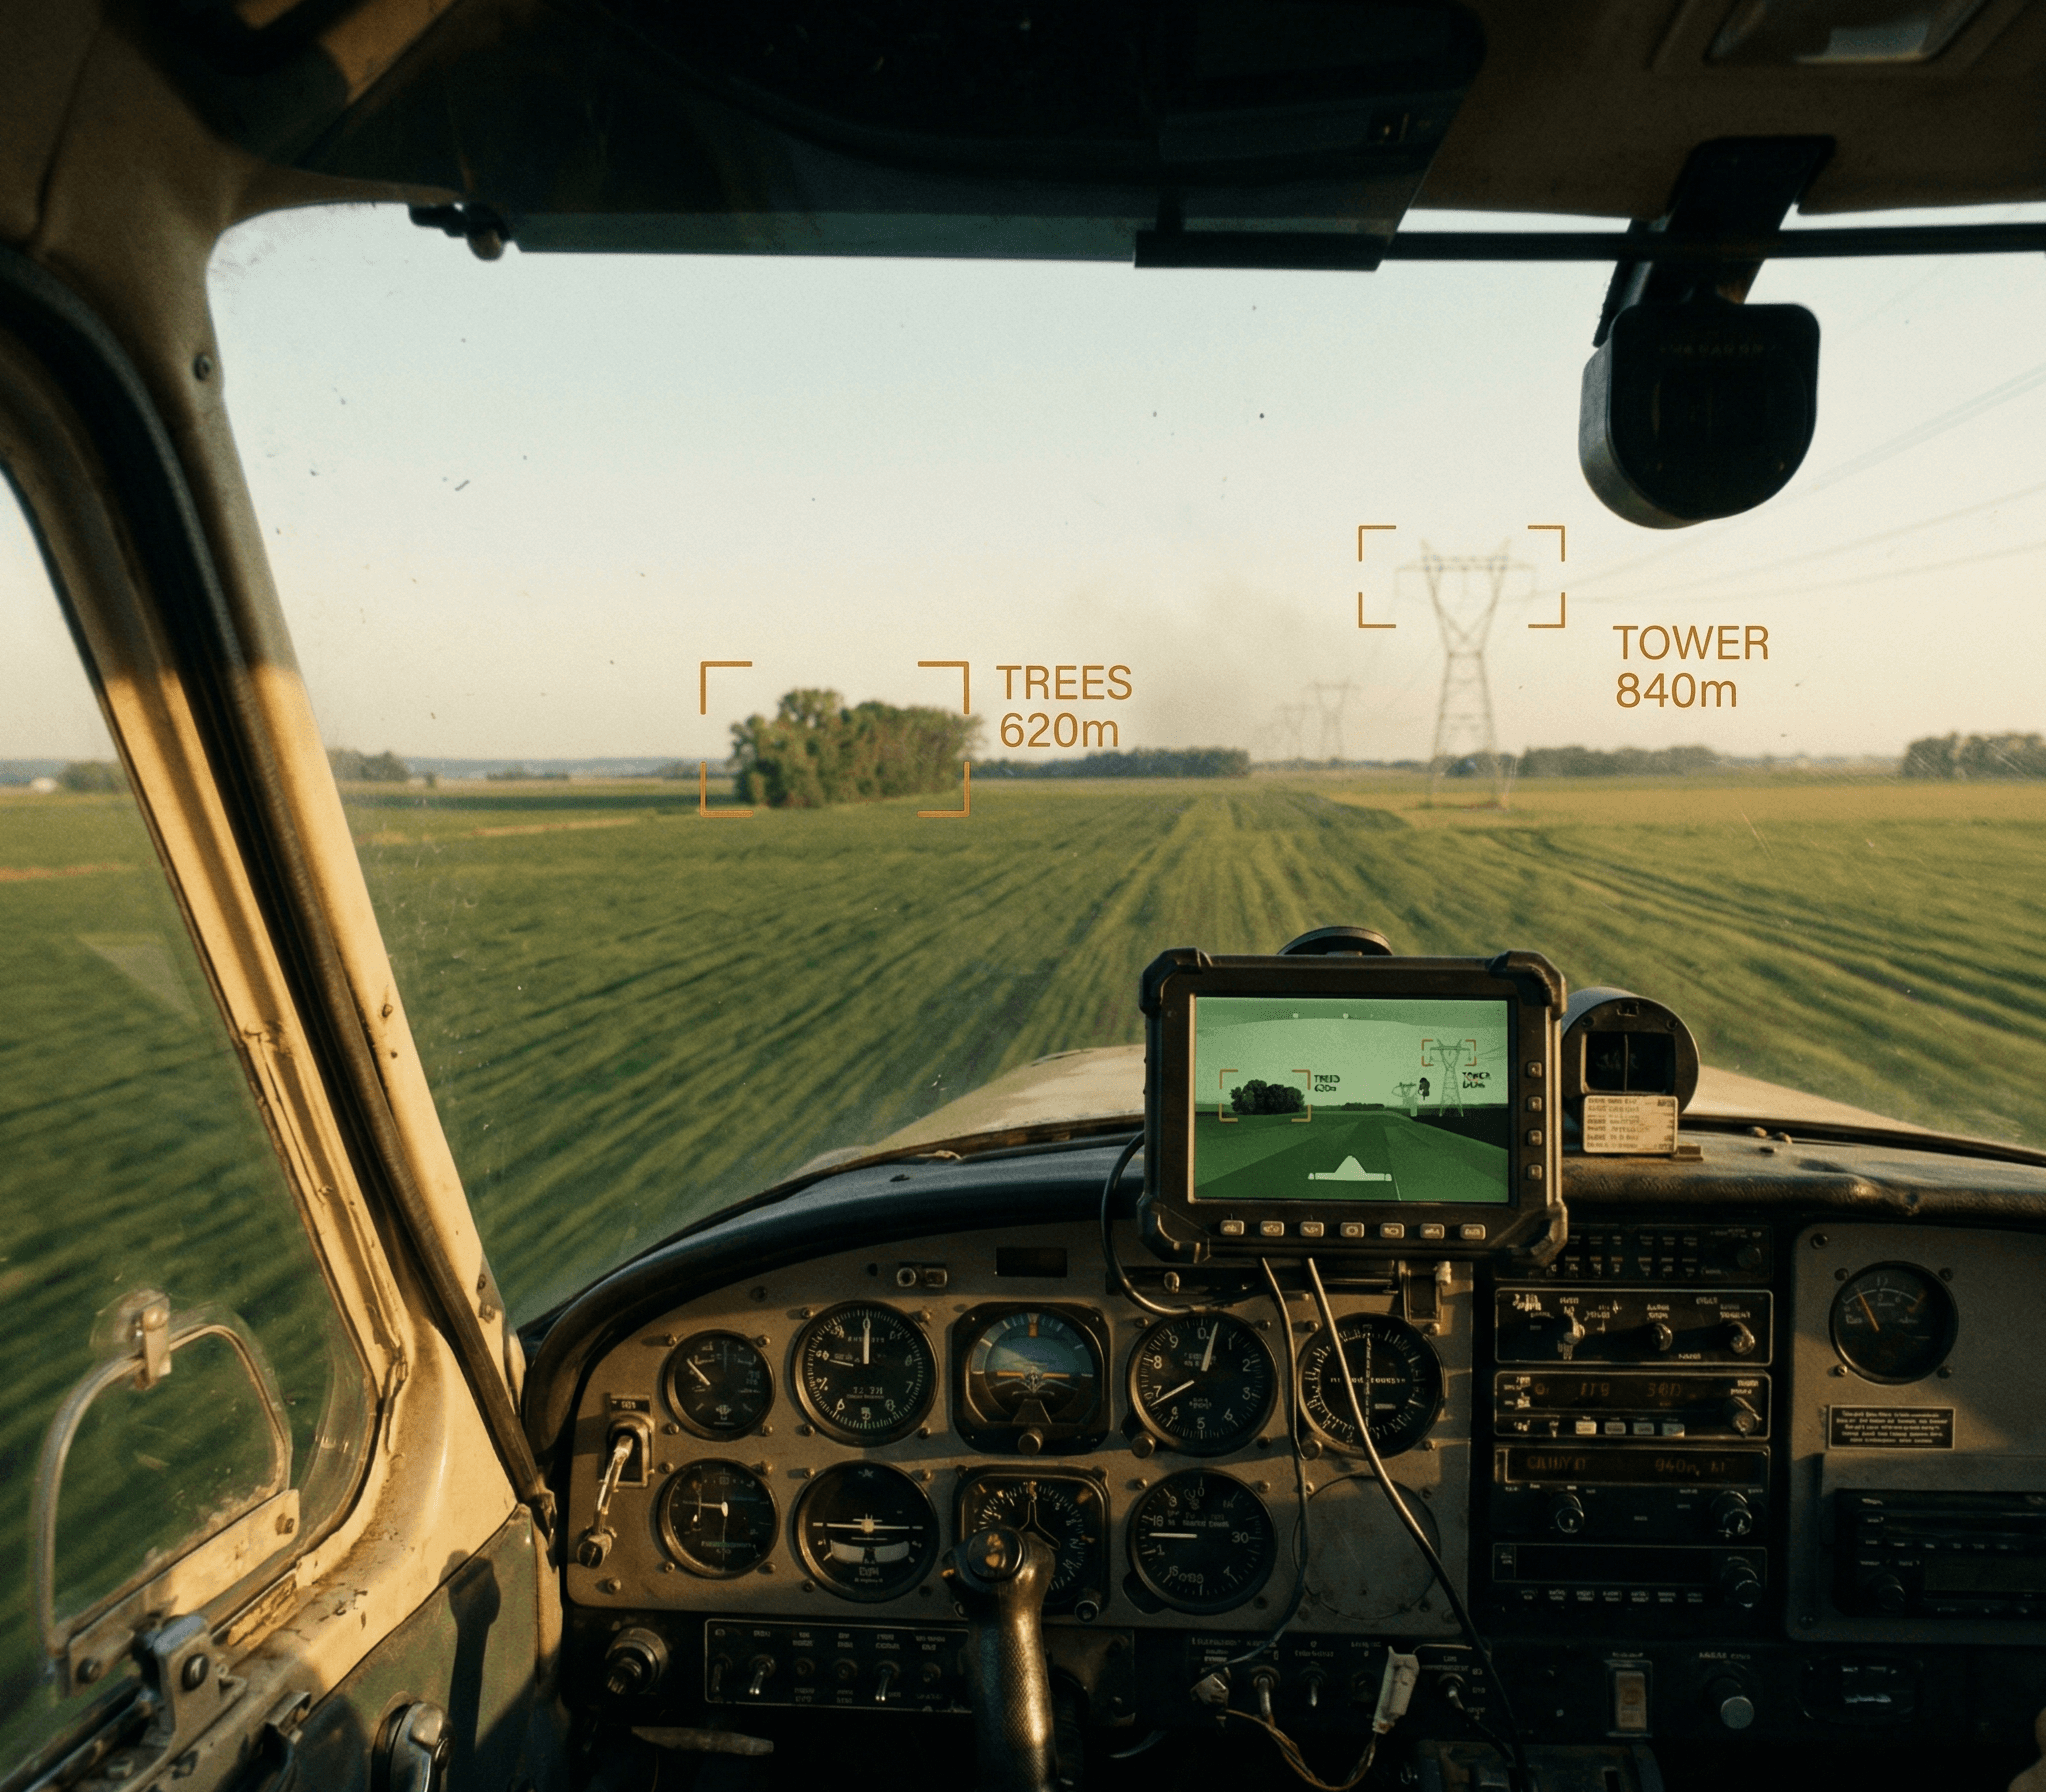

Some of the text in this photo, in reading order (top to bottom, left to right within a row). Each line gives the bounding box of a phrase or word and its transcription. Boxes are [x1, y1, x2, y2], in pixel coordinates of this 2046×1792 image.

[1153, 1355, 1163, 1369] 8
[1242, 1359, 1251, 1372] 2
[1231, 1531, 1249, 1544] 30
